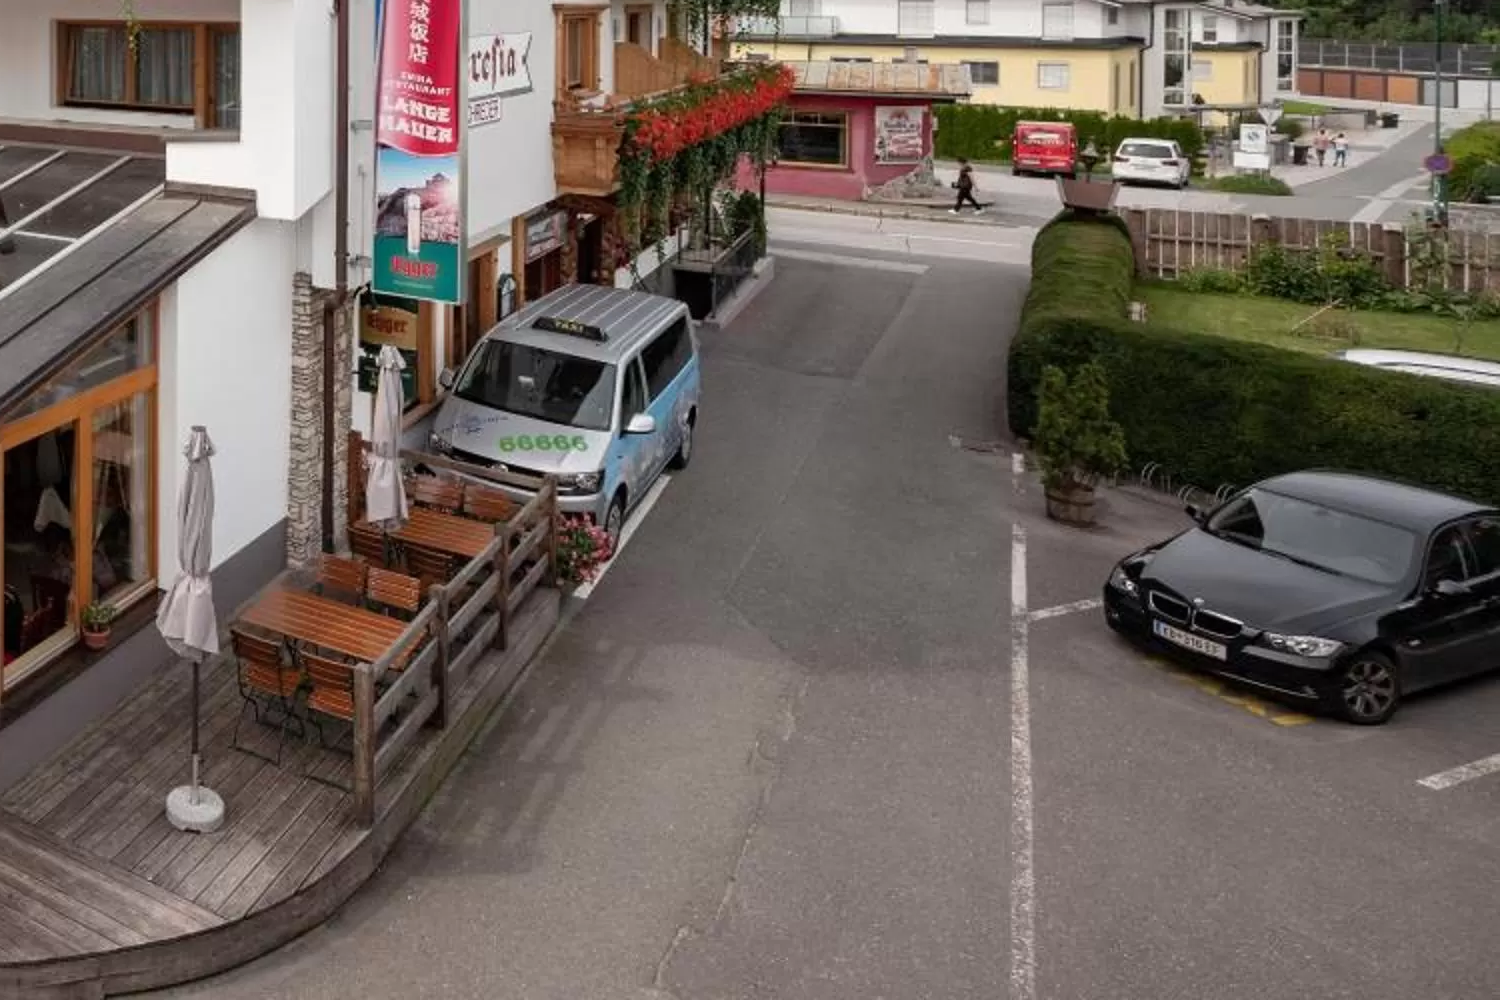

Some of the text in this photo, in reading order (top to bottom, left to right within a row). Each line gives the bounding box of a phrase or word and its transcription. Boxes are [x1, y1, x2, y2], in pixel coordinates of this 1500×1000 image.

[382, 95, 451, 123] LANGE
[380, 115, 453, 143] MAUER
[555, 318, 584, 334] TAXI
[500, 434, 588, 452] 66666
